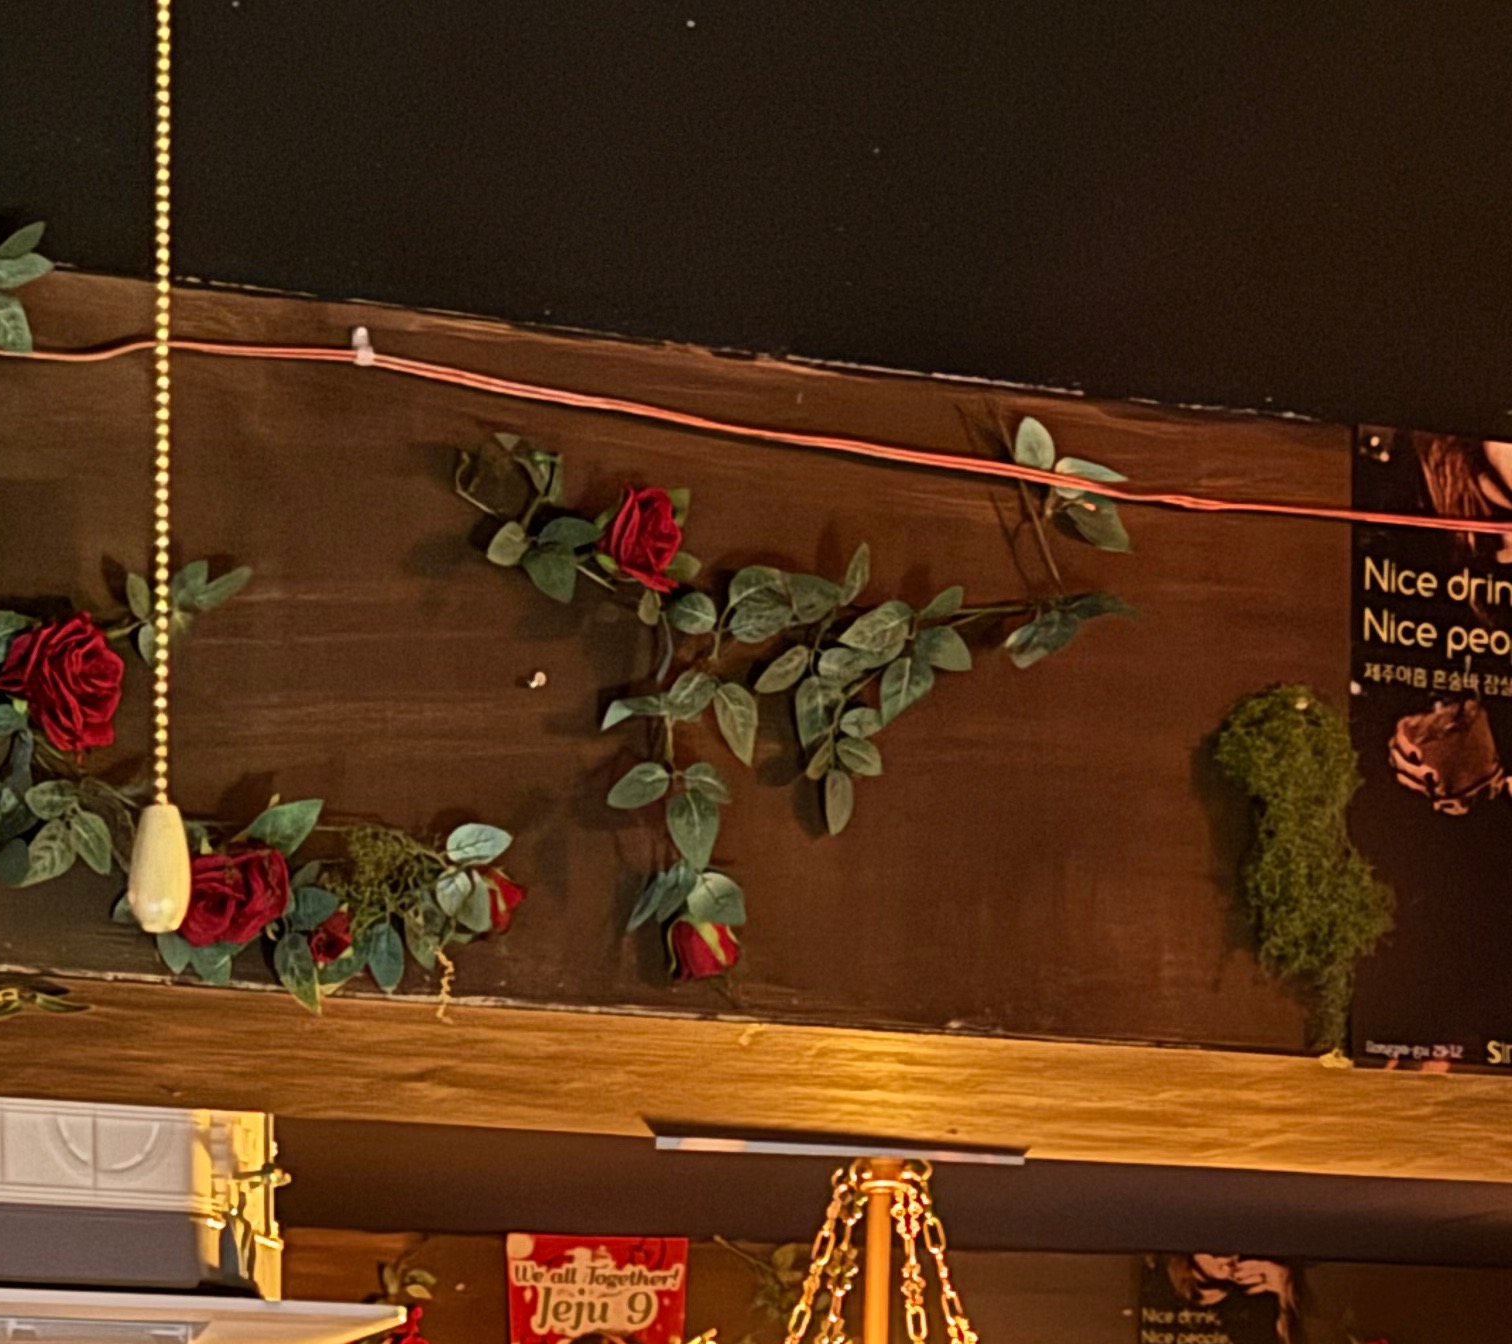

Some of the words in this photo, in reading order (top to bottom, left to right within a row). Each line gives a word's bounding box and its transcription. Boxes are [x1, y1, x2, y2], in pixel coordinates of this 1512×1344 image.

[1364, 556, 1438, 598] Nice
[1363, 606, 1438, 648] Nice
[1446, 626, 1512, 663] peo
[514, 1264, 545, 1283] We
[550, 1266, 577, 1284] all
[586, 1264, 680, 1288] Together!
[537, 1286, 609, 1331] Jeju
[627, 1291, 653, 1325] 9
